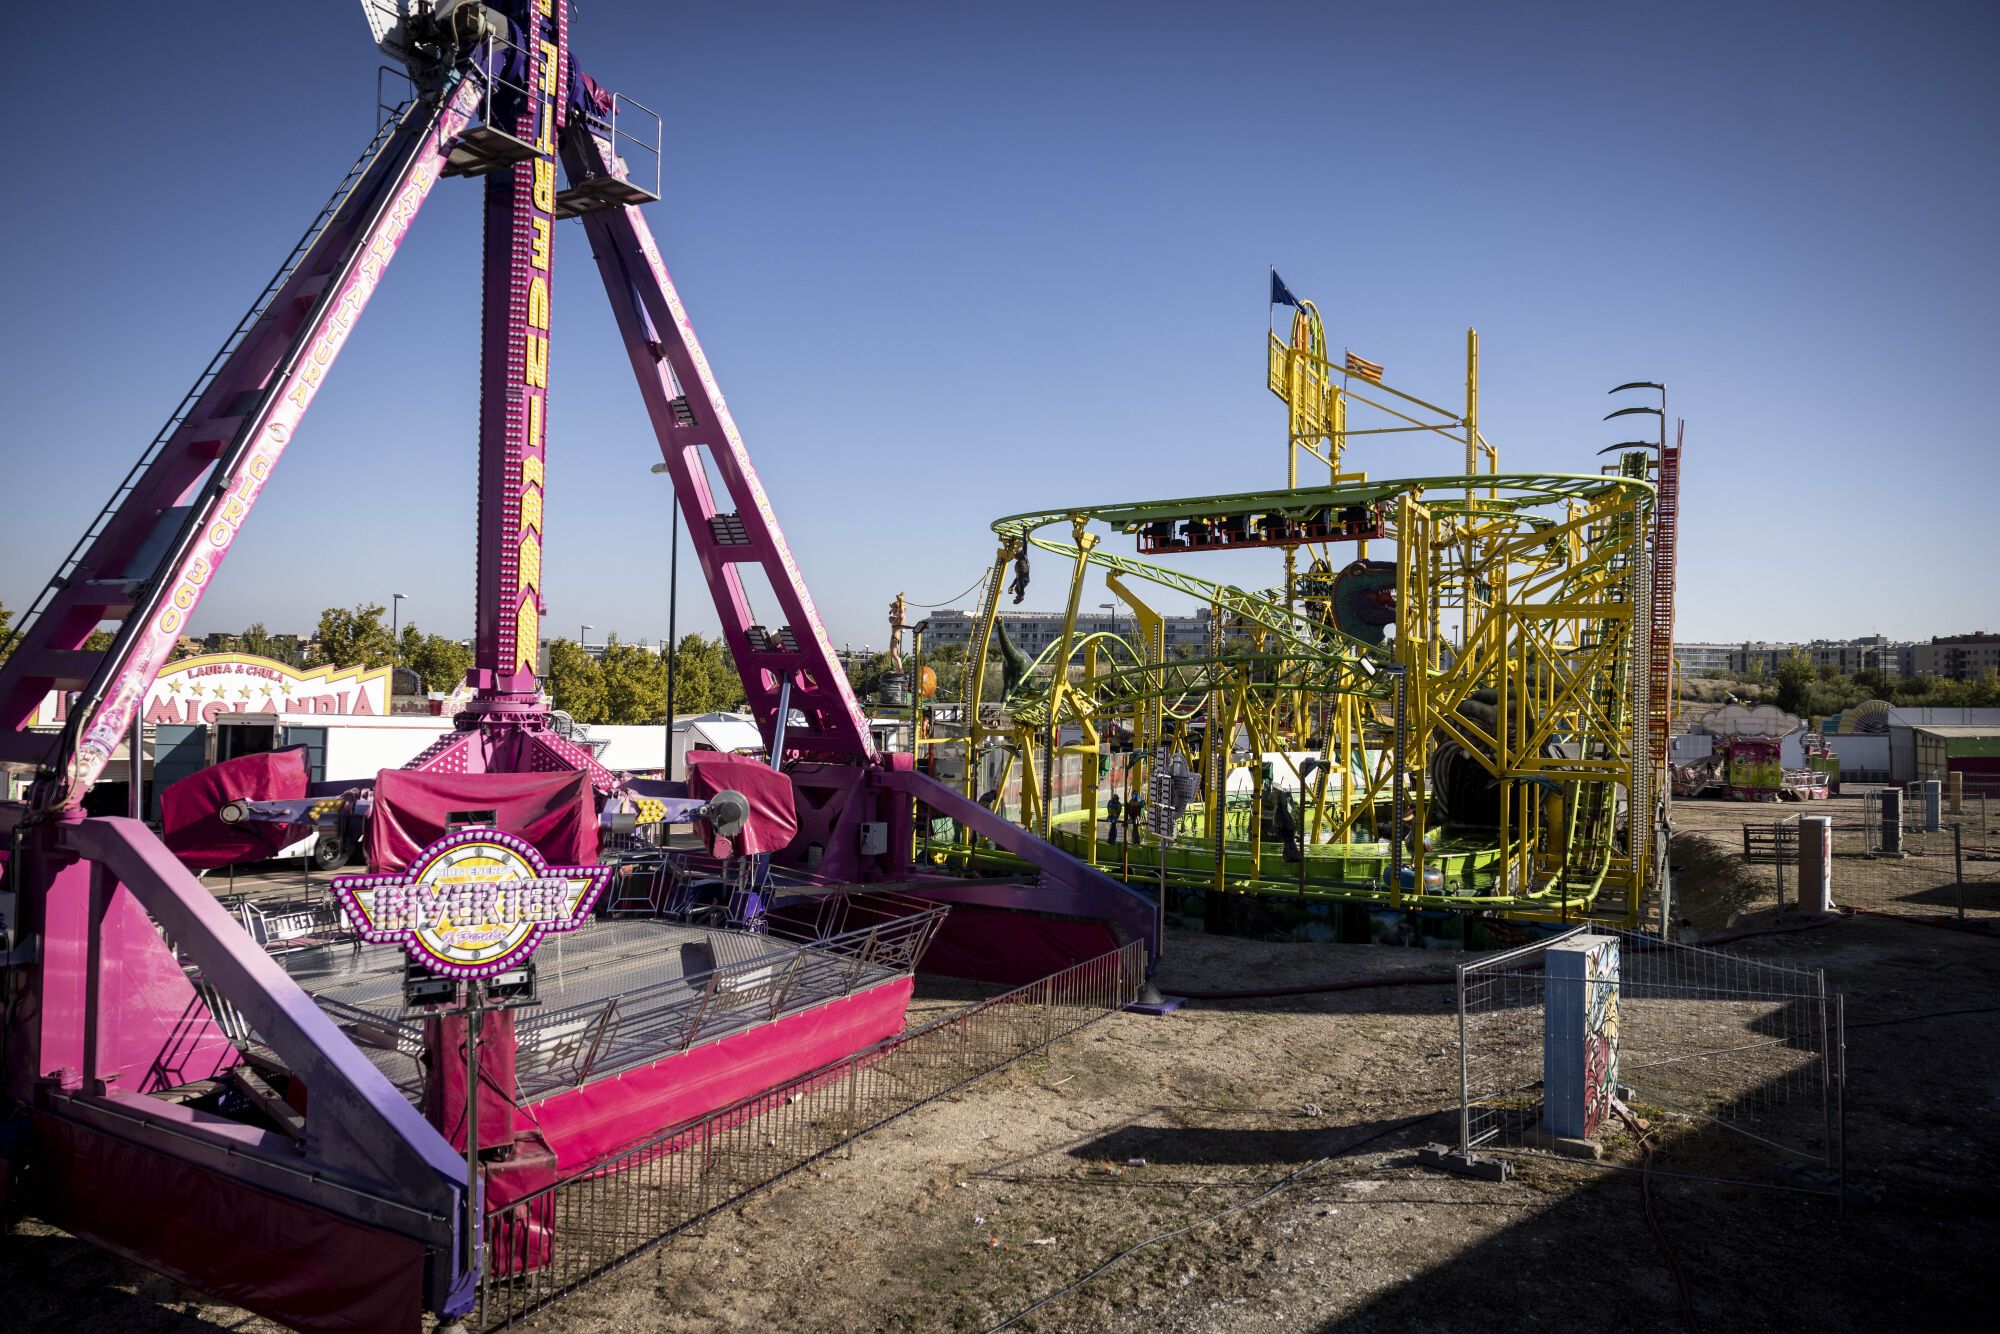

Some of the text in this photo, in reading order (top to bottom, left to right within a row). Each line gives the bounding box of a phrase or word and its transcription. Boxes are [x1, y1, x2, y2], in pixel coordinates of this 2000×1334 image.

[287, 166, 432, 408] MAXIMA ALTURA
[646, 246, 685, 322] GIRO
[158, 454, 270, 635] GIRO 360
[724, 424, 841, 673] MAXIMA VELOCIDAD
[187, 663, 284, 684] LAURA & CHULA
[373, 877, 572, 933] INVERTER
